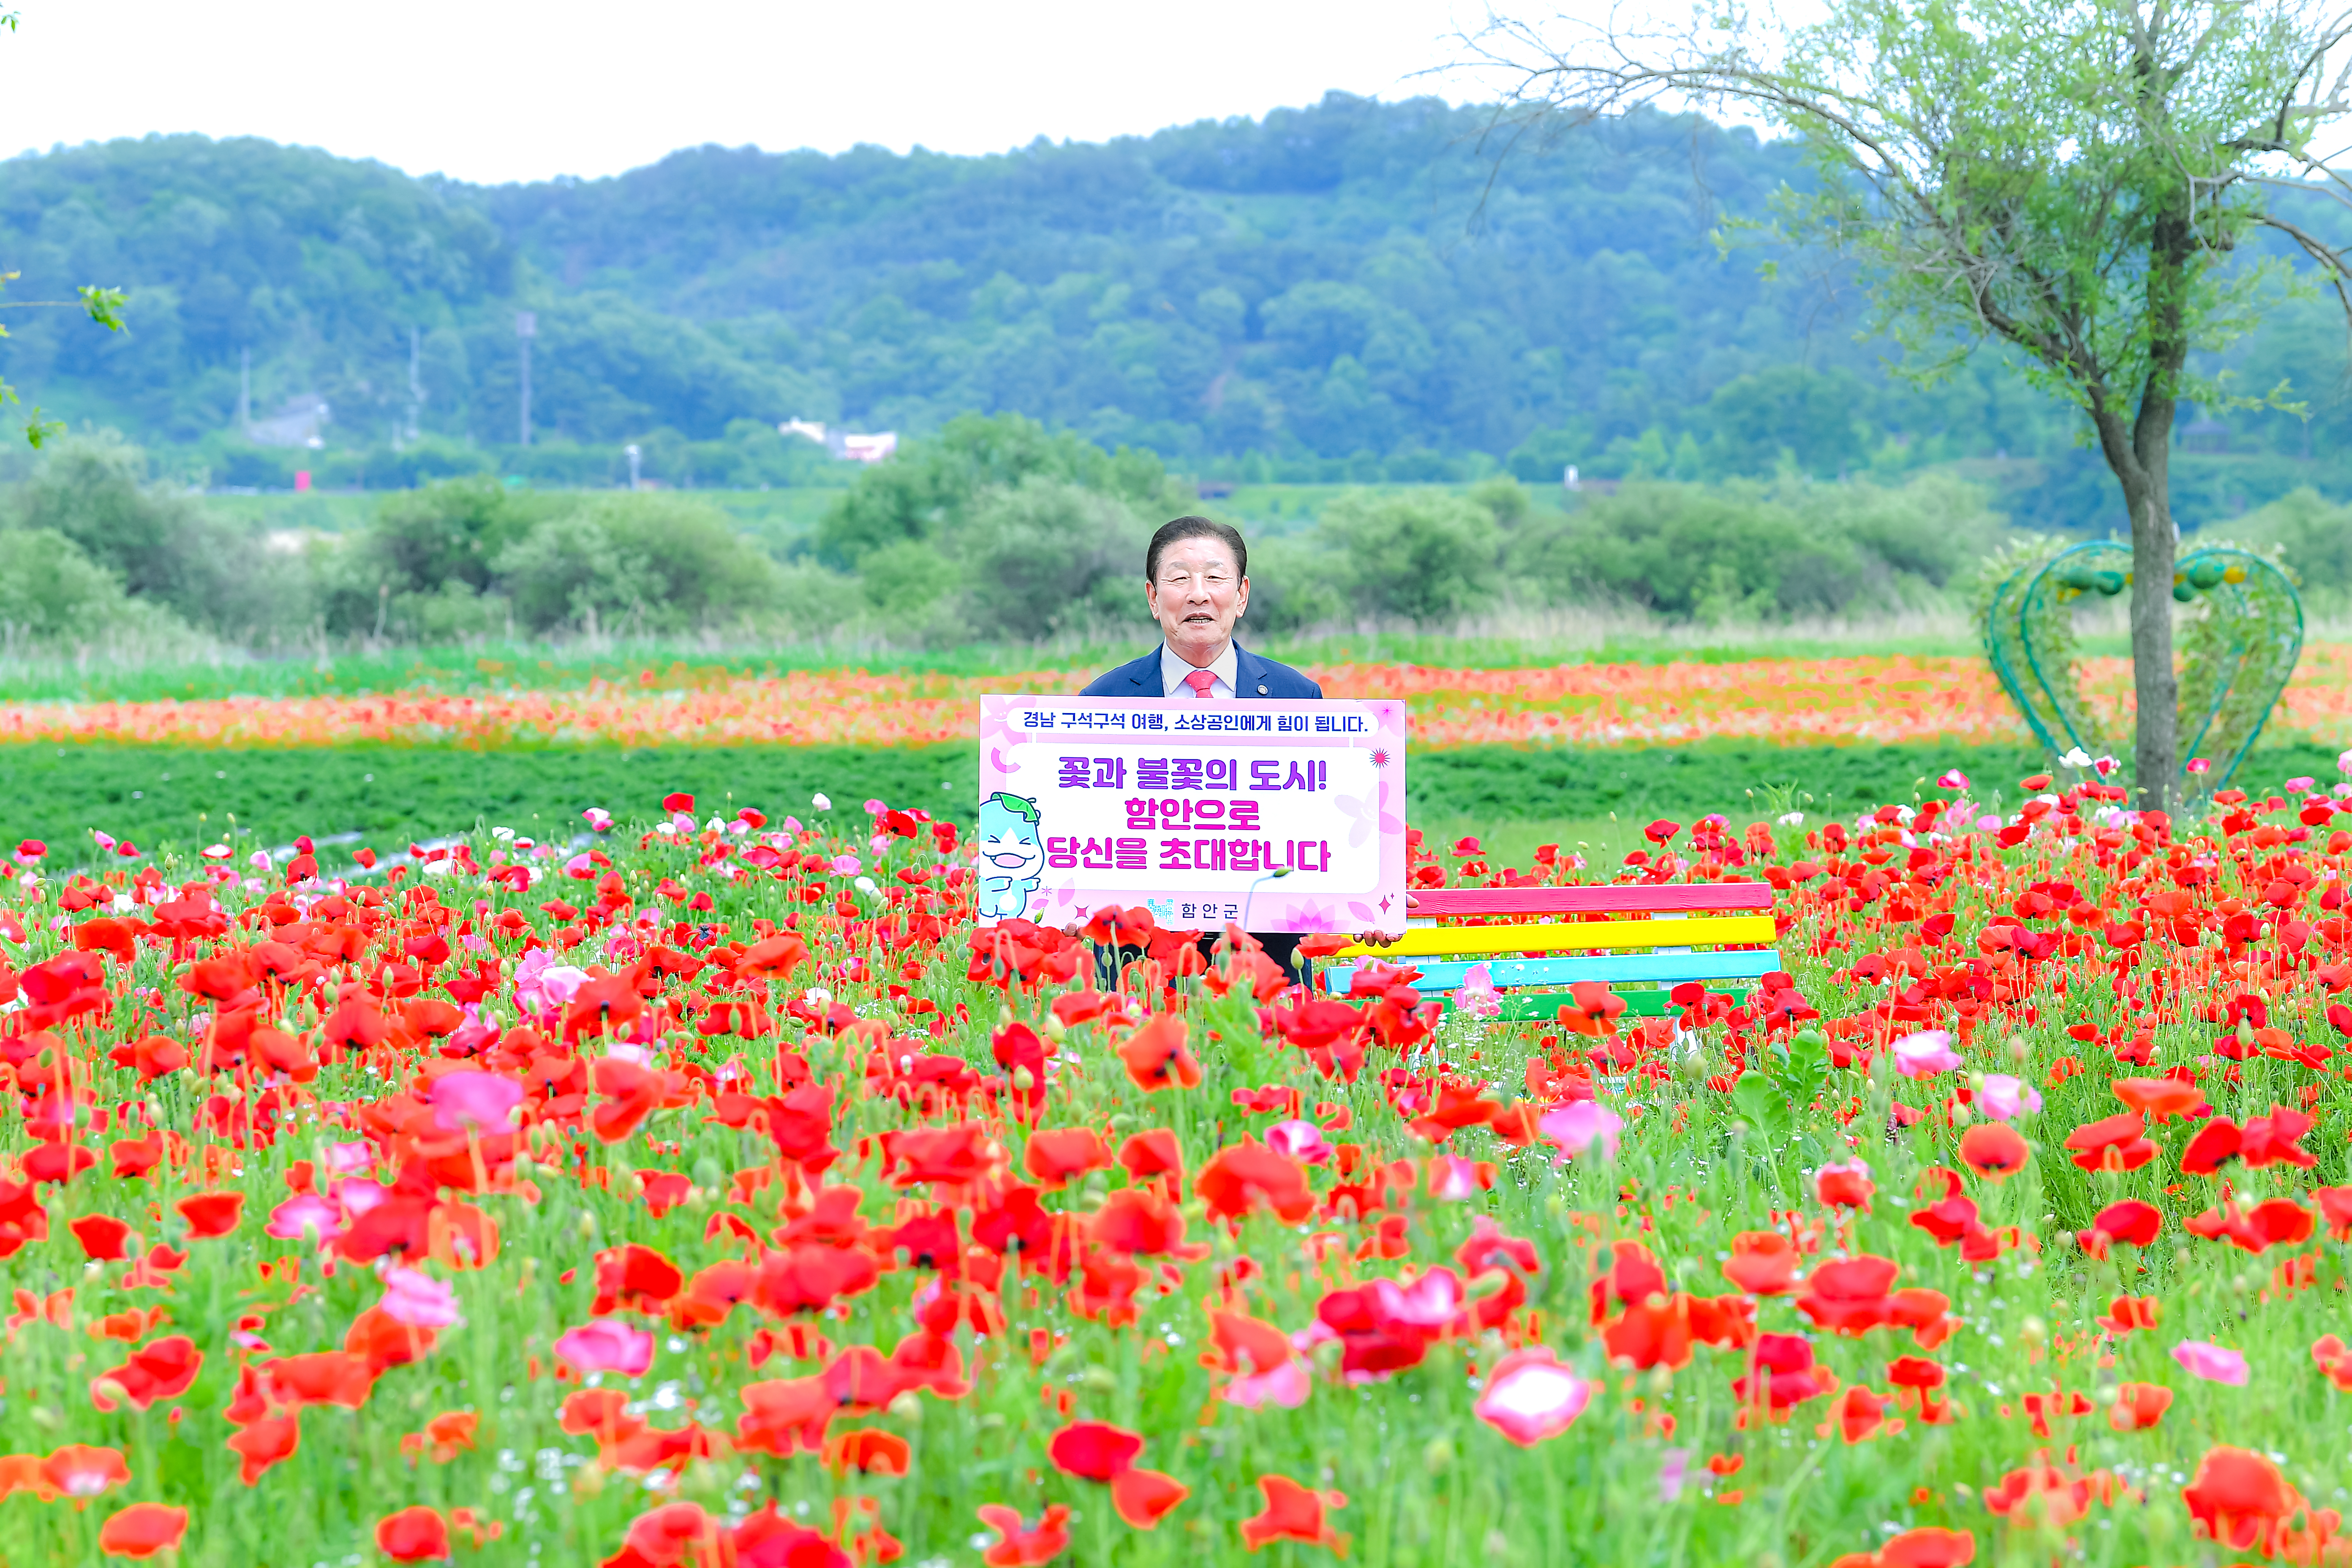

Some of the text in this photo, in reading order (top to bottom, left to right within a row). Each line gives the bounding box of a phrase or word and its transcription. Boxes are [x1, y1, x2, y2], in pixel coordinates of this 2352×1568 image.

[1024, 712, 1368, 732] 경남 구석구석 여행, 소상공인에게 힘이 됩니다.
[1059, 757, 1326, 792] 꽃과 불꽃의 도시!
[1124, 798, 1260, 830] 함안으로
[1047, 836, 1331, 872] 당신을 초대합니다
